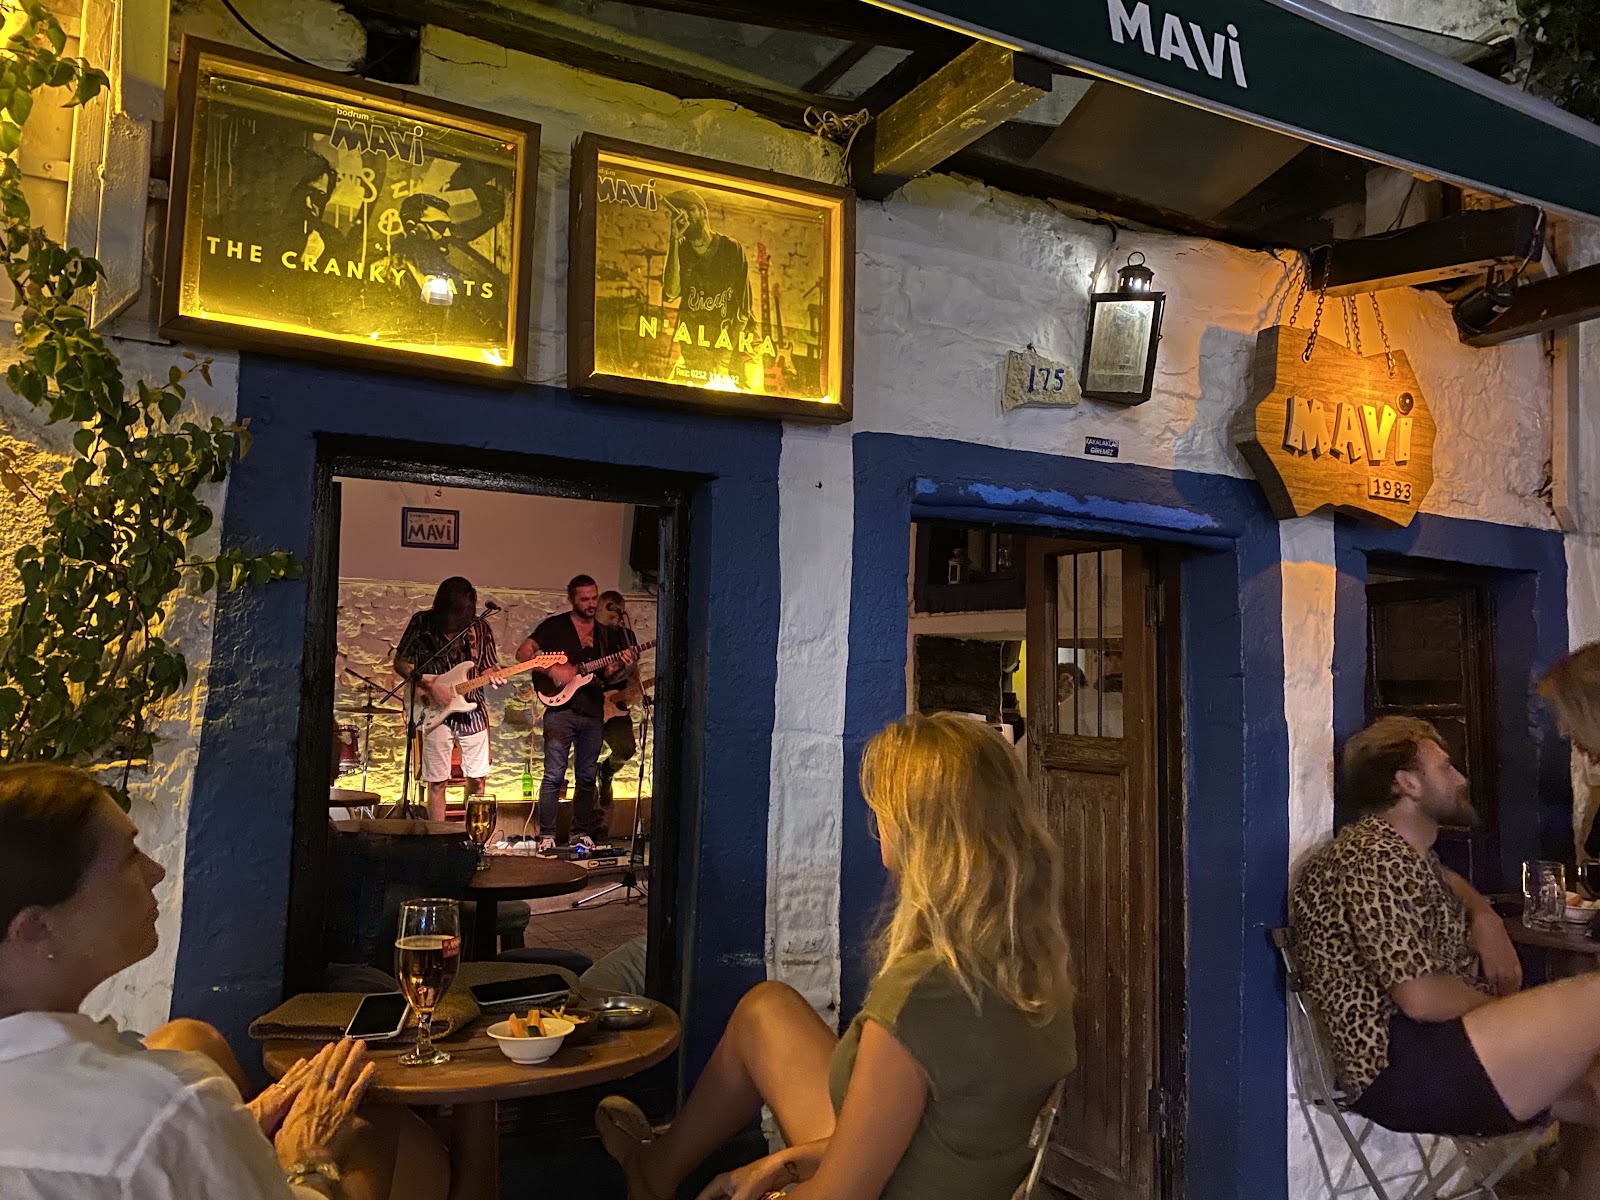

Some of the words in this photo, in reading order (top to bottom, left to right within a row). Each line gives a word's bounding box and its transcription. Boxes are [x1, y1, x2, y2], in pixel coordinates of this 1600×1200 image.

[1107, 0, 1248, 88] MAVi
[336, 107, 369, 121] bodrum
[329, 118, 423, 166] MAVi
[598, 167, 616, 176] drum
[206, 236, 262, 263] THE
[281, 251, 406, 286] CRANKY
[1027, 365, 1065, 394] 175
[1283, 392, 1414, 464] MAVi
[1372, 478, 1412, 499] 1983
